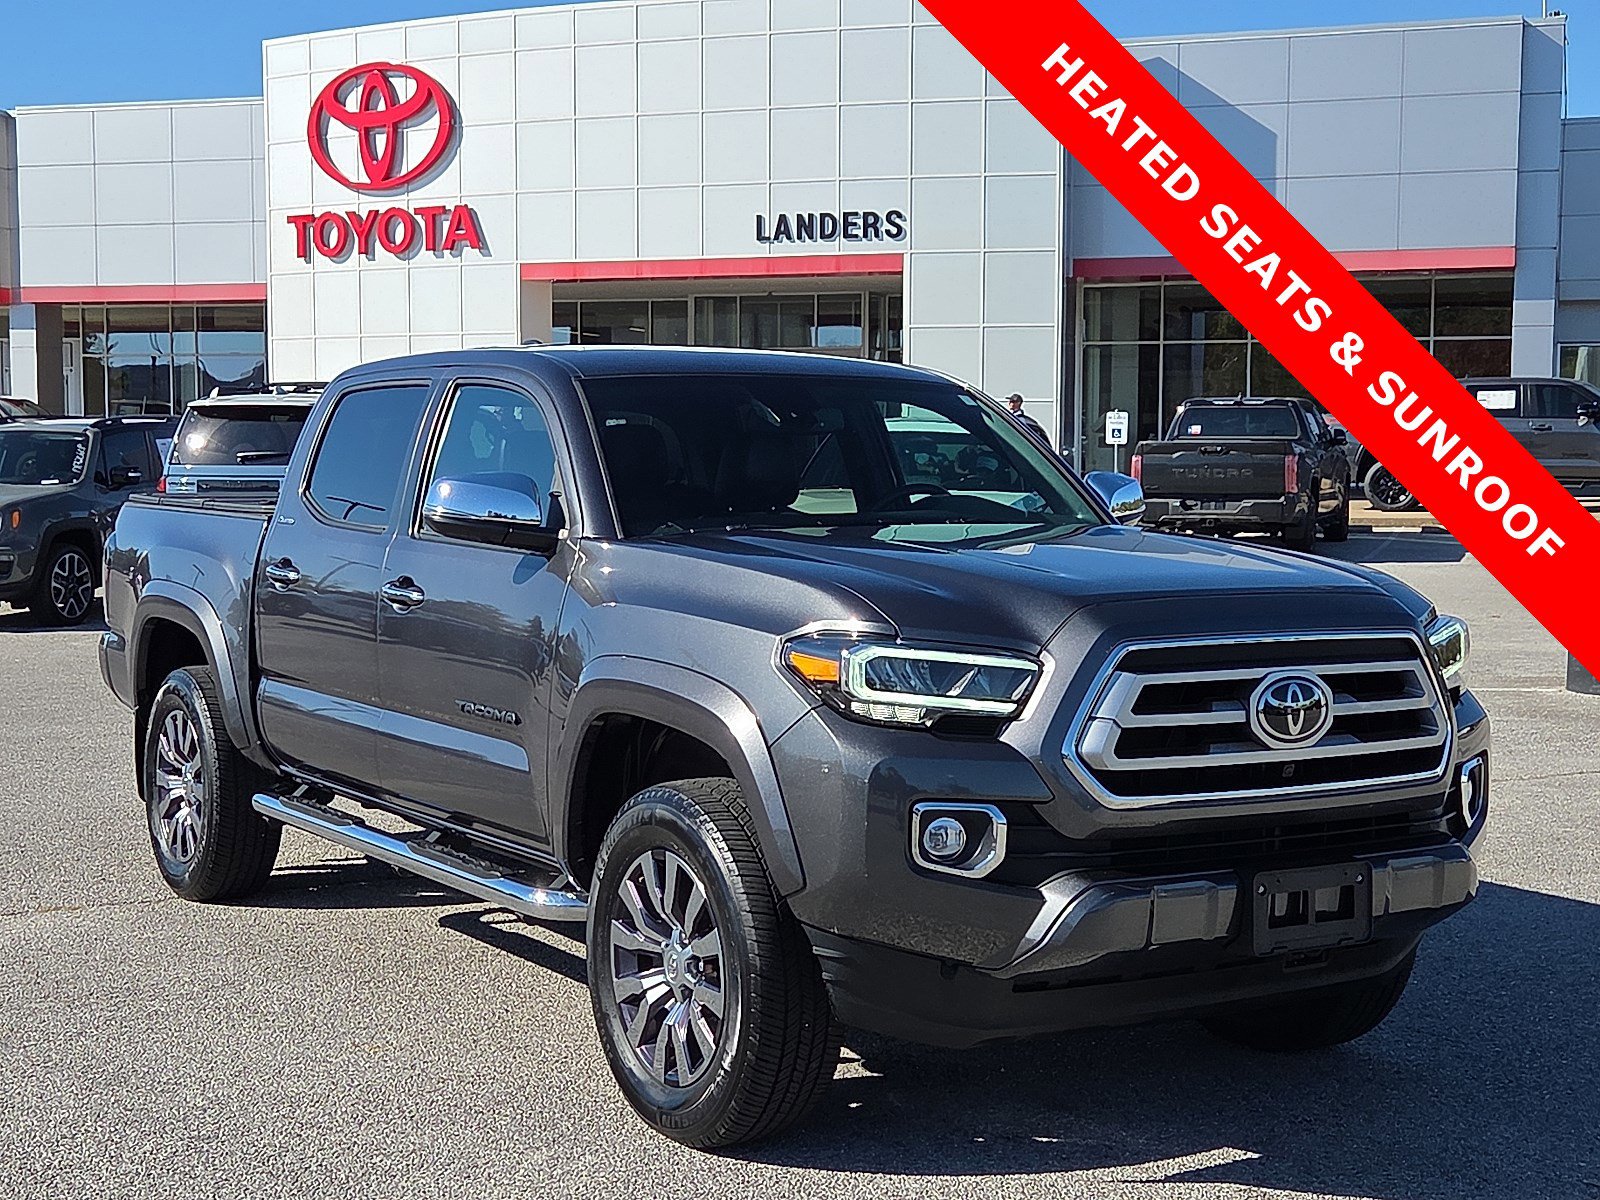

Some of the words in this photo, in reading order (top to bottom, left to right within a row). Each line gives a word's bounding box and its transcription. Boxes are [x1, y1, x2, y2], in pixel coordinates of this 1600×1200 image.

[287, 204, 482, 259] TOYOTA
[756, 210, 906, 242] LANDERS
[454, 699, 520, 725] TACOMA
